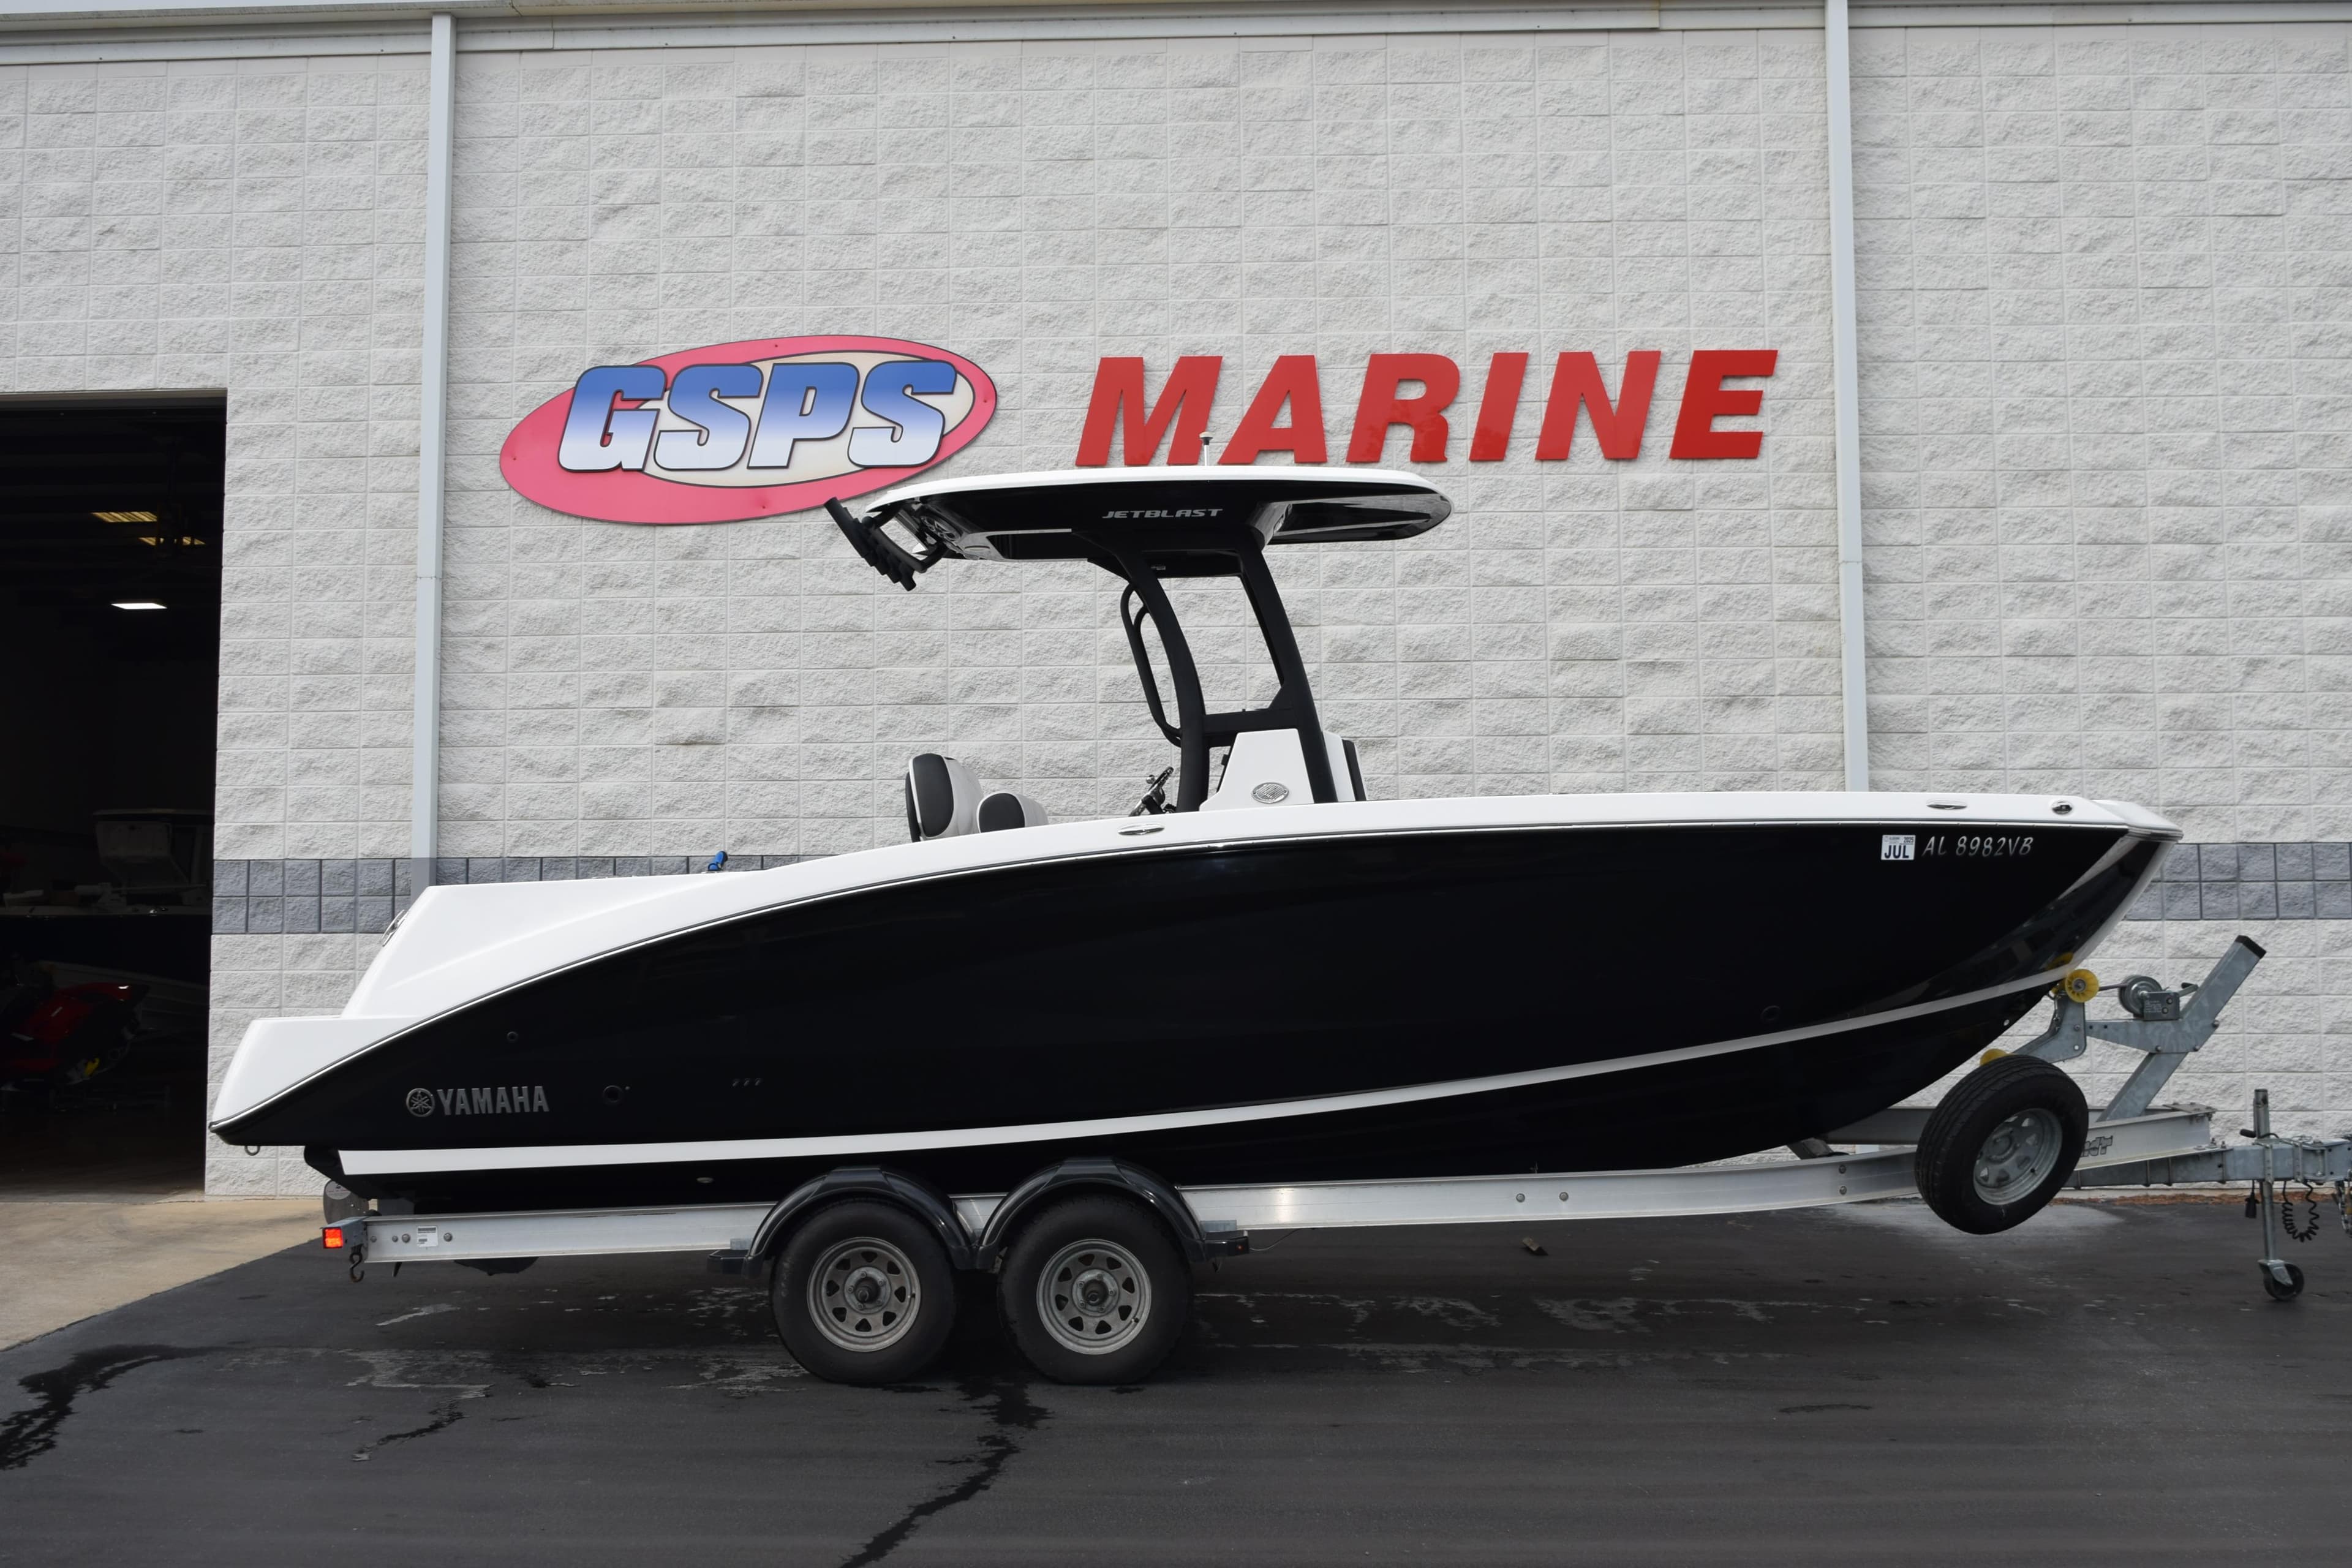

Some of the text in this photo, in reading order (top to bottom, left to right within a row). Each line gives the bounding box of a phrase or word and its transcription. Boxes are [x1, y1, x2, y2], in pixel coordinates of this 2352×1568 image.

[559, 360, 957, 472] GSPS
[1075, 350, 1778, 466] MARINE
[1102, 508, 1223, 519] JETBLAST
[1884, 845, 1910, 859] JUL
[1922, 836, 2034, 857] AL 8982VB
[436, 1086, 549, 1116] YAMAHA
